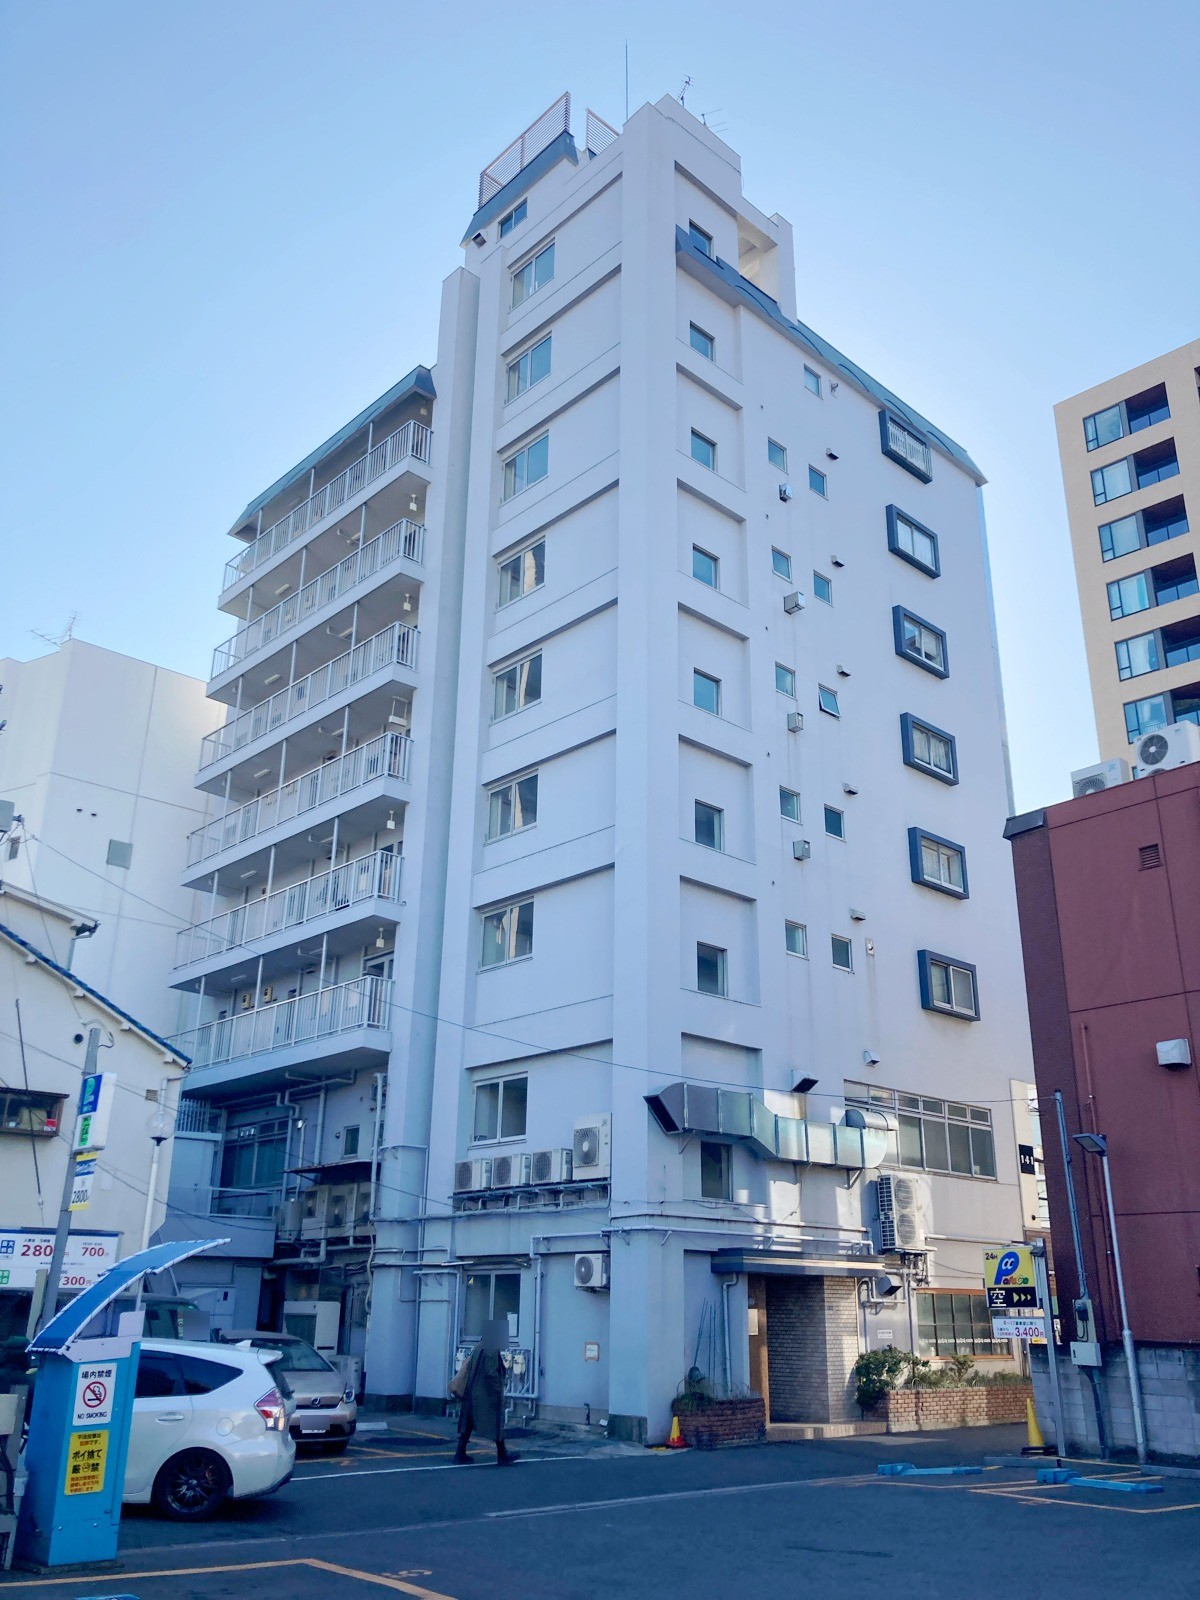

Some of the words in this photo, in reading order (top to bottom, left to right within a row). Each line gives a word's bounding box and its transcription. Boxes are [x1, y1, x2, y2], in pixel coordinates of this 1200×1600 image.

[1020, 1154, 1034, 1165] 141
[990, 1288, 1007, 1307] 空
[81, 1369, 112, 1379] 場内禁煙
[86, 1411, 107, 1419] SMOKING
[72, 1449, 103, 1460] ポイ捨て
